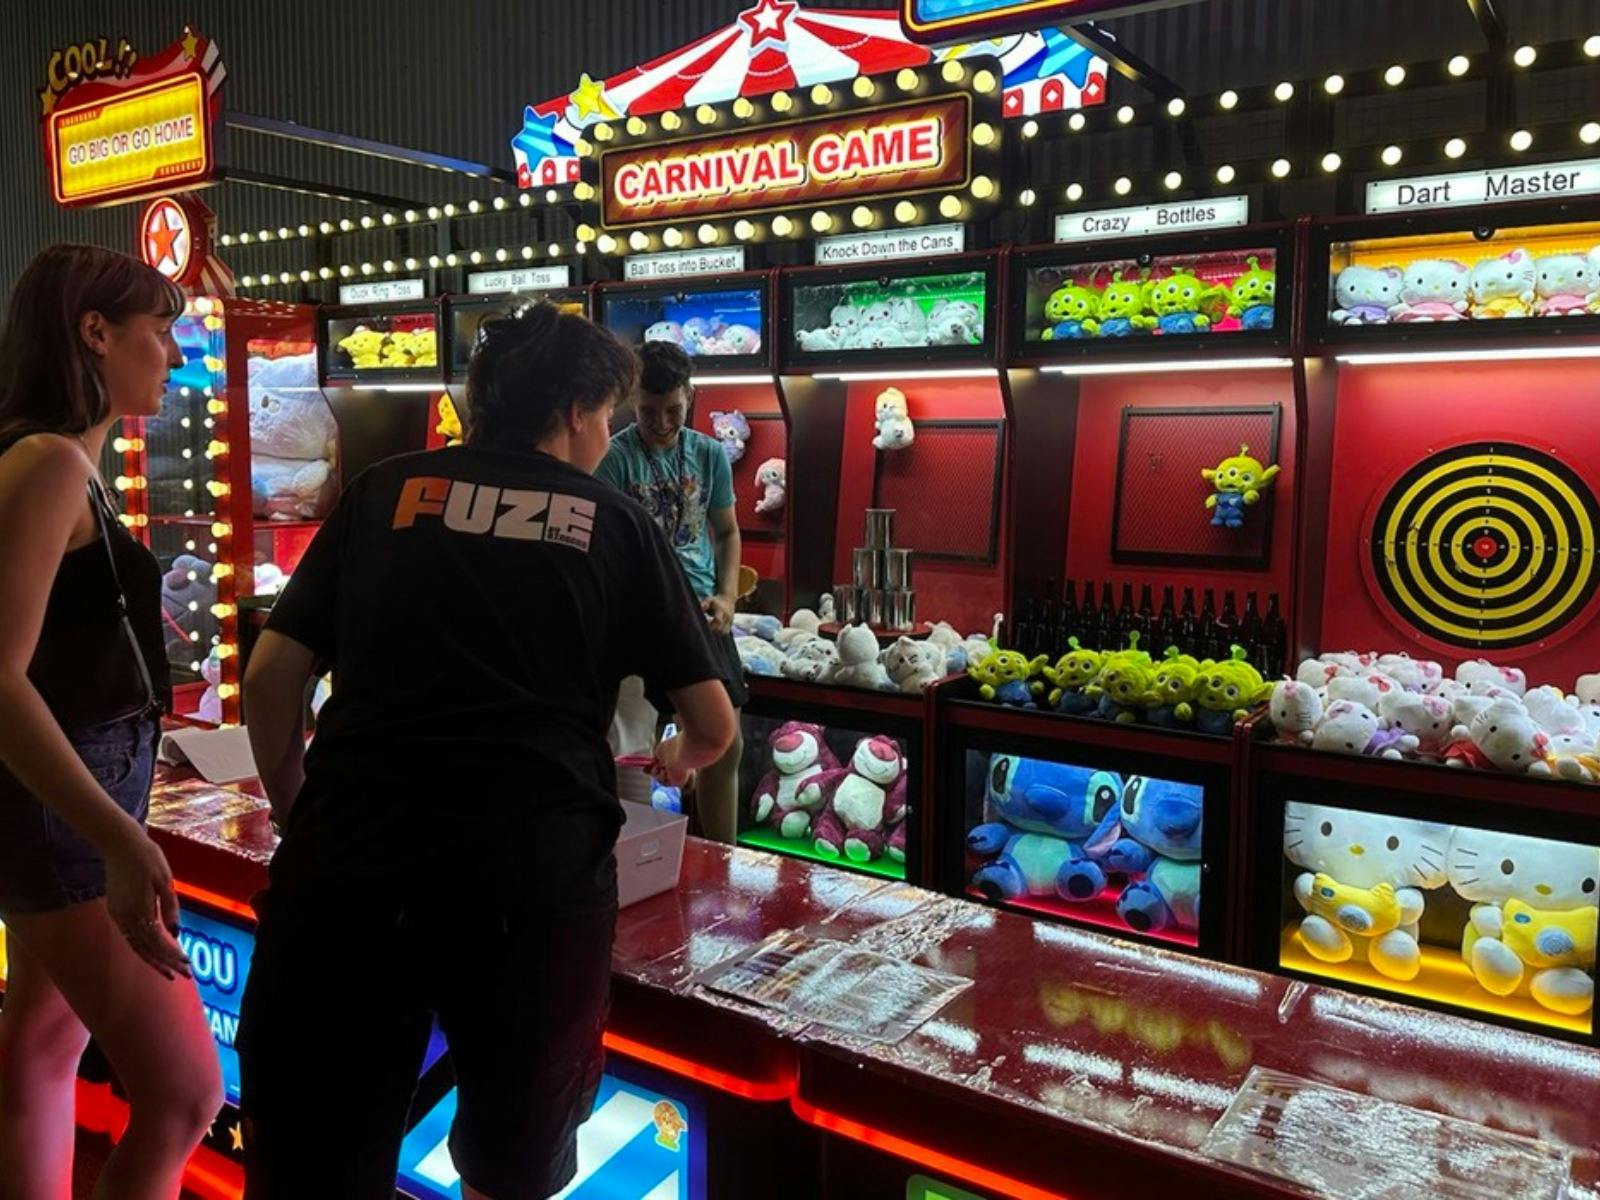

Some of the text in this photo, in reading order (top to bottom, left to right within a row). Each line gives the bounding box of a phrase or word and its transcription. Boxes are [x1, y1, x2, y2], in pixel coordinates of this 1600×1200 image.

[69, 117, 194, 165] GO BIG OR GO HOME
[617, 123, 936, 201] CARNIVAL GAME
[1397, 170, 1581, 206] Dart Master
[1082, 206, 1217, 233] Crazy Bottles
[822, 236, 955, 260] Knock Down the Cans
[631, 255, 737, 276] Ball Toss into Bucket
[392, 283, 412, 296] Toss
[484, 270, 552, 289] Lucky Ball Toss
[391, 476, 597, 553] FUZE
